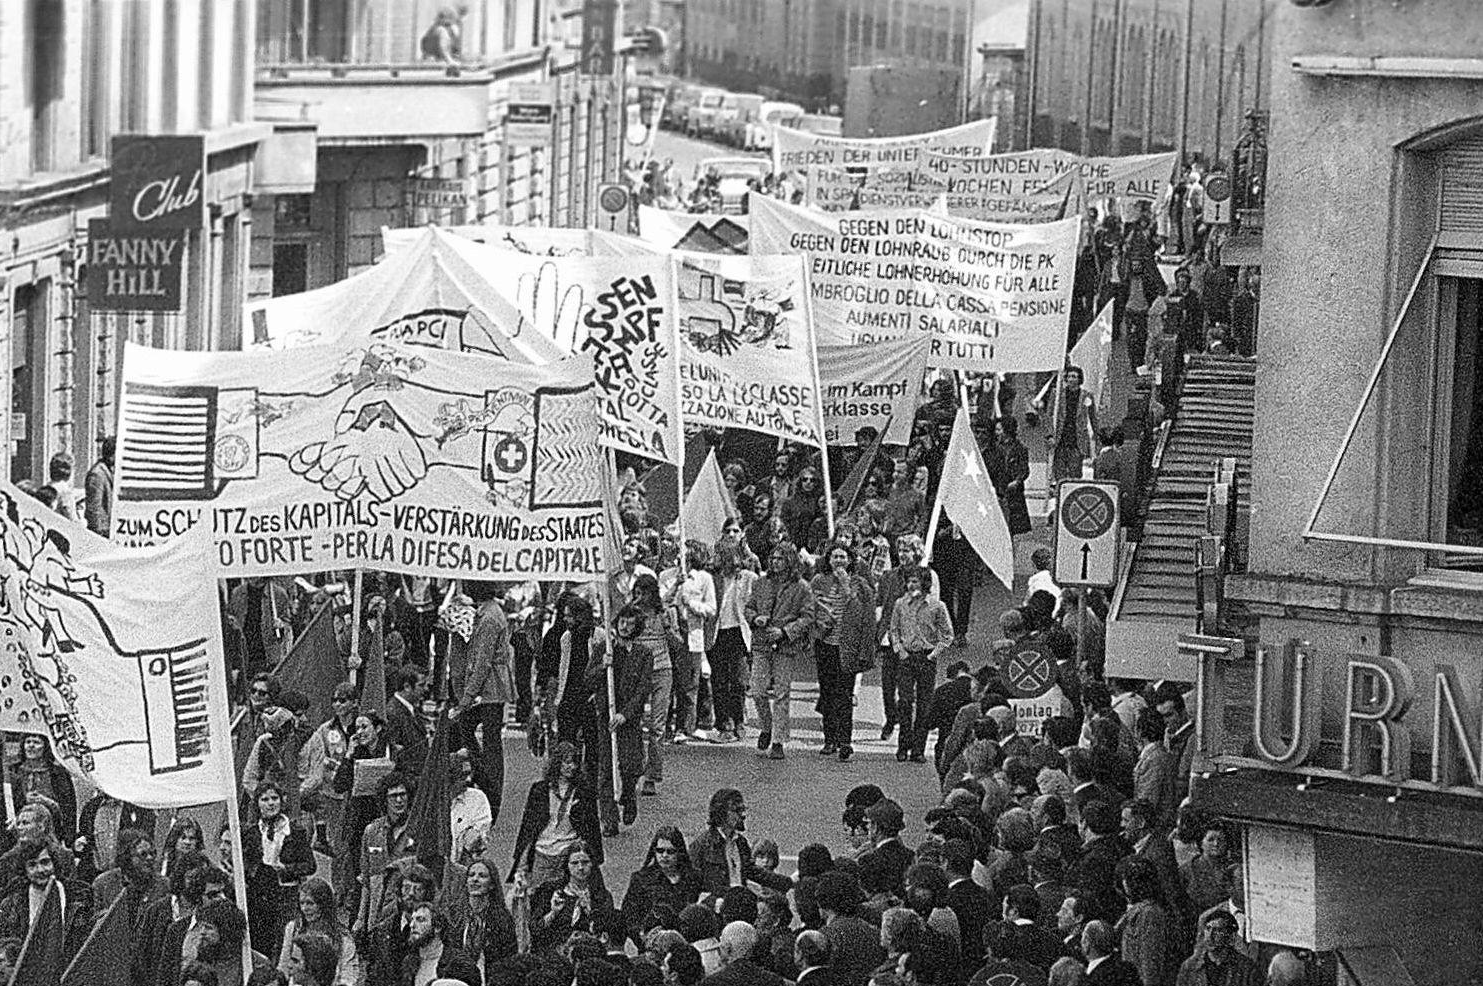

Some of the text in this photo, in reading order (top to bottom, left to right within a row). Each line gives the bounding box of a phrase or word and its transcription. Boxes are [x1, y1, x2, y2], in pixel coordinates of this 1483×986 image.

[132, 169, 201, 221] Club
[1127, 180, 1160, 196] ALLE
[839, 219, 889, 236] GEGEN
[896, 218, 925, 235] DEN
[92, 238, 178, 265] FANNY
[790, 233, 834, 252] GEGEN
[840, 237, 869, 254] DEN
[958, 248, 1005, 268] DURCH
[1010, 253, 1033, 270] DIE
[1038, 253, 1056, 270] PK
[995, 272, 1023, 293] FÜR
[1028, 274, 1060, 292] ALLE
[896, 289, 942, 309] DELLA
[946, 294, 996, 315] CASSA
[1001, 299, 1067, 318] PENSIONE
[846, 309, 1000, 338] AUMENTI SALARIALI
[946, 340, 994, 359] TUTTI
[851, 379, 908, 400] Kampf
[117, 518, 153, 537] ZUM
[250, 514, 281, 533] DES
[521, 523, 545, 541] DES
[545, 512, 605, 542] STAATES
[240, 535, 314, 565] FORTE
[401, 537, 473, 571] DIFESA
[477, 550, 514, 573] DEL
[515, 545, 605, 574] CAPITALE
